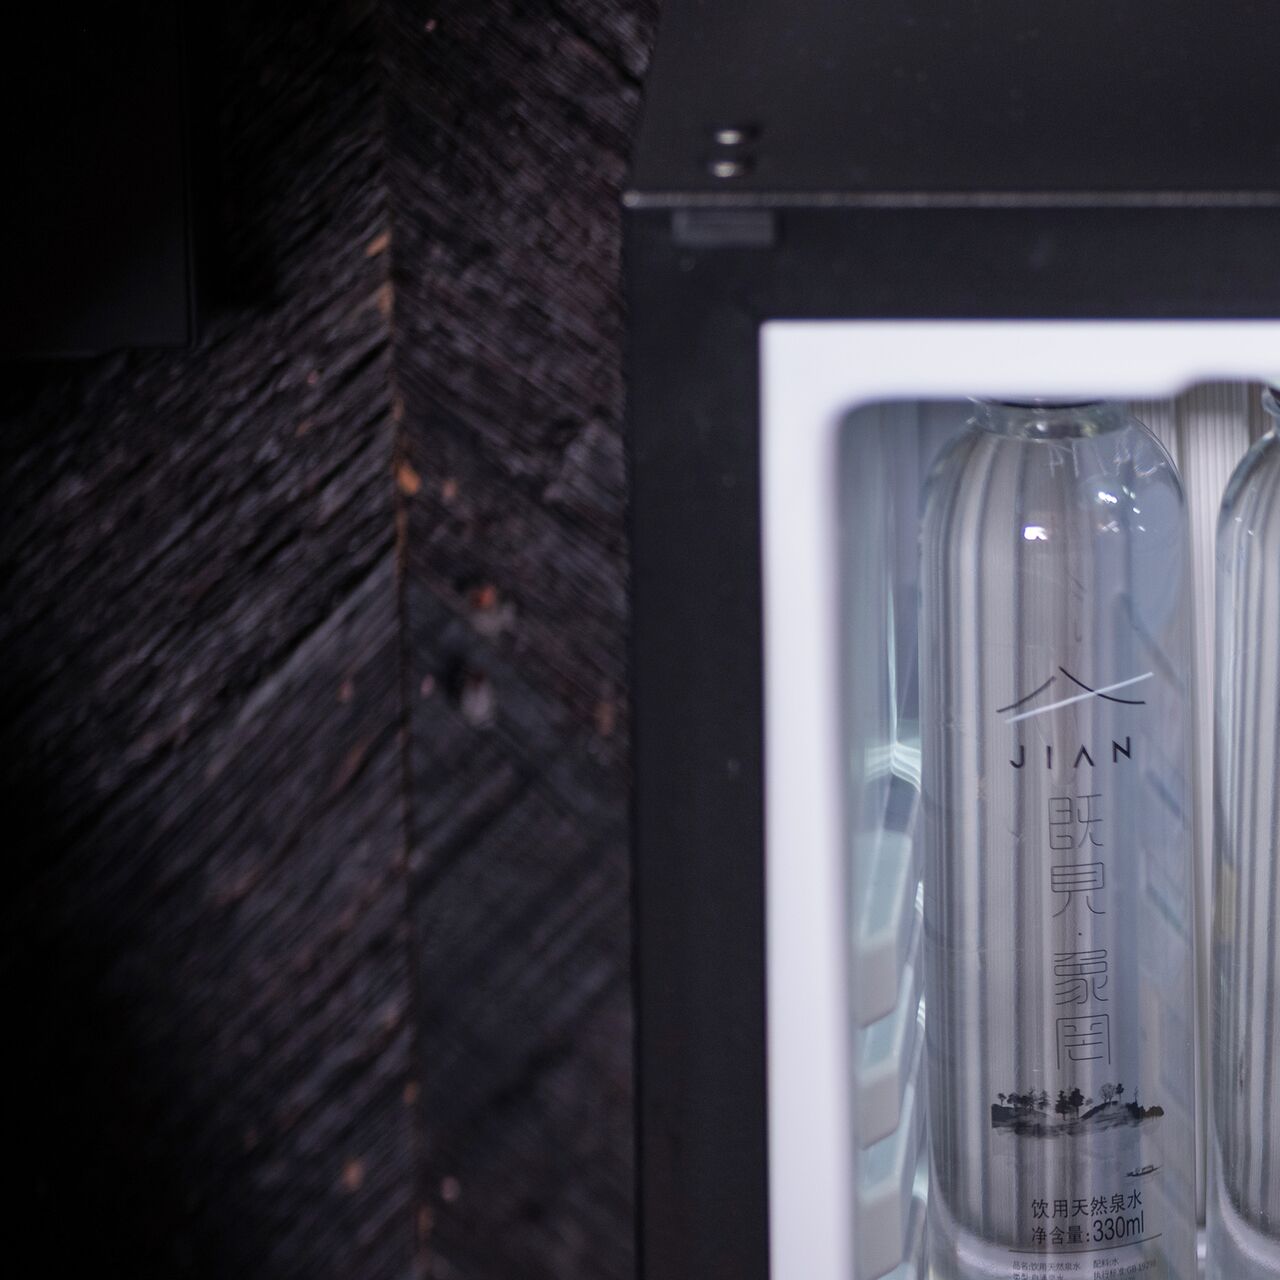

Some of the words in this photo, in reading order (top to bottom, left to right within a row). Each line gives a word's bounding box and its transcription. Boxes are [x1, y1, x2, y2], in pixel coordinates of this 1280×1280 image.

[1009, 736, 1132, 769] JIAN
[1031, 1189, 1143, 1219] 饮用天然泉水
